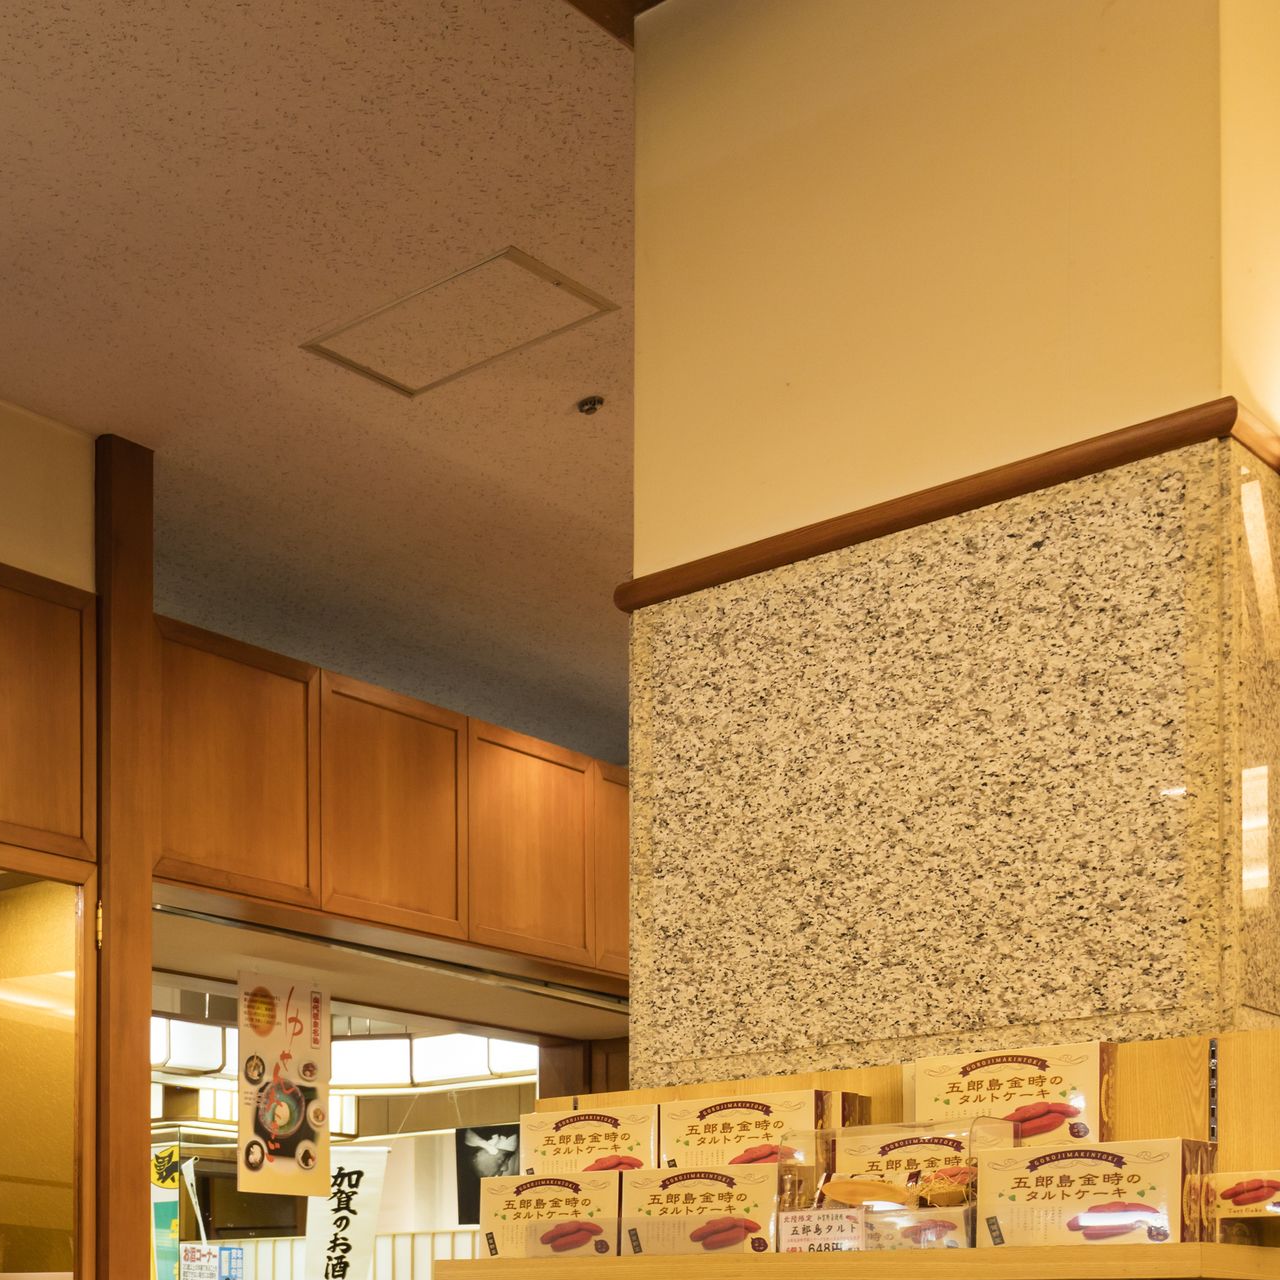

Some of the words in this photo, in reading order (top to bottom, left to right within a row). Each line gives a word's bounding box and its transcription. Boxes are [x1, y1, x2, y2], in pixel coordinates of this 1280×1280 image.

[945, 1074, 1063, 1095] 五郎島金時の
[959, 1089, 1051, 1105] タルトケーキ
[685, 1120, 784, 1136] 五郎島金時の
[543, 1132, 631, 1147] 五郎島金時の
[697, 1133, 773, 1146] タルトケーキ
[552, 1144, 622, 1156] タルトケーキ
[1011, 1172, 1141, 1190] 五郎島金時の
[648, 1192, 748, 1206] 五郎島金時の
[1026, 1187, 1127, 1201] タルトケーキ
[503, 1197, 592, 1211] 五郎島金時の
[658, 1205, 737, 1216] タルトケーキ
[512, 1209, 582, 1221] タルトケーキ
[324, 1166, 364, 1280] 加賀のお酒
[790, 1223, 857, 1236] 五郎島タルト
